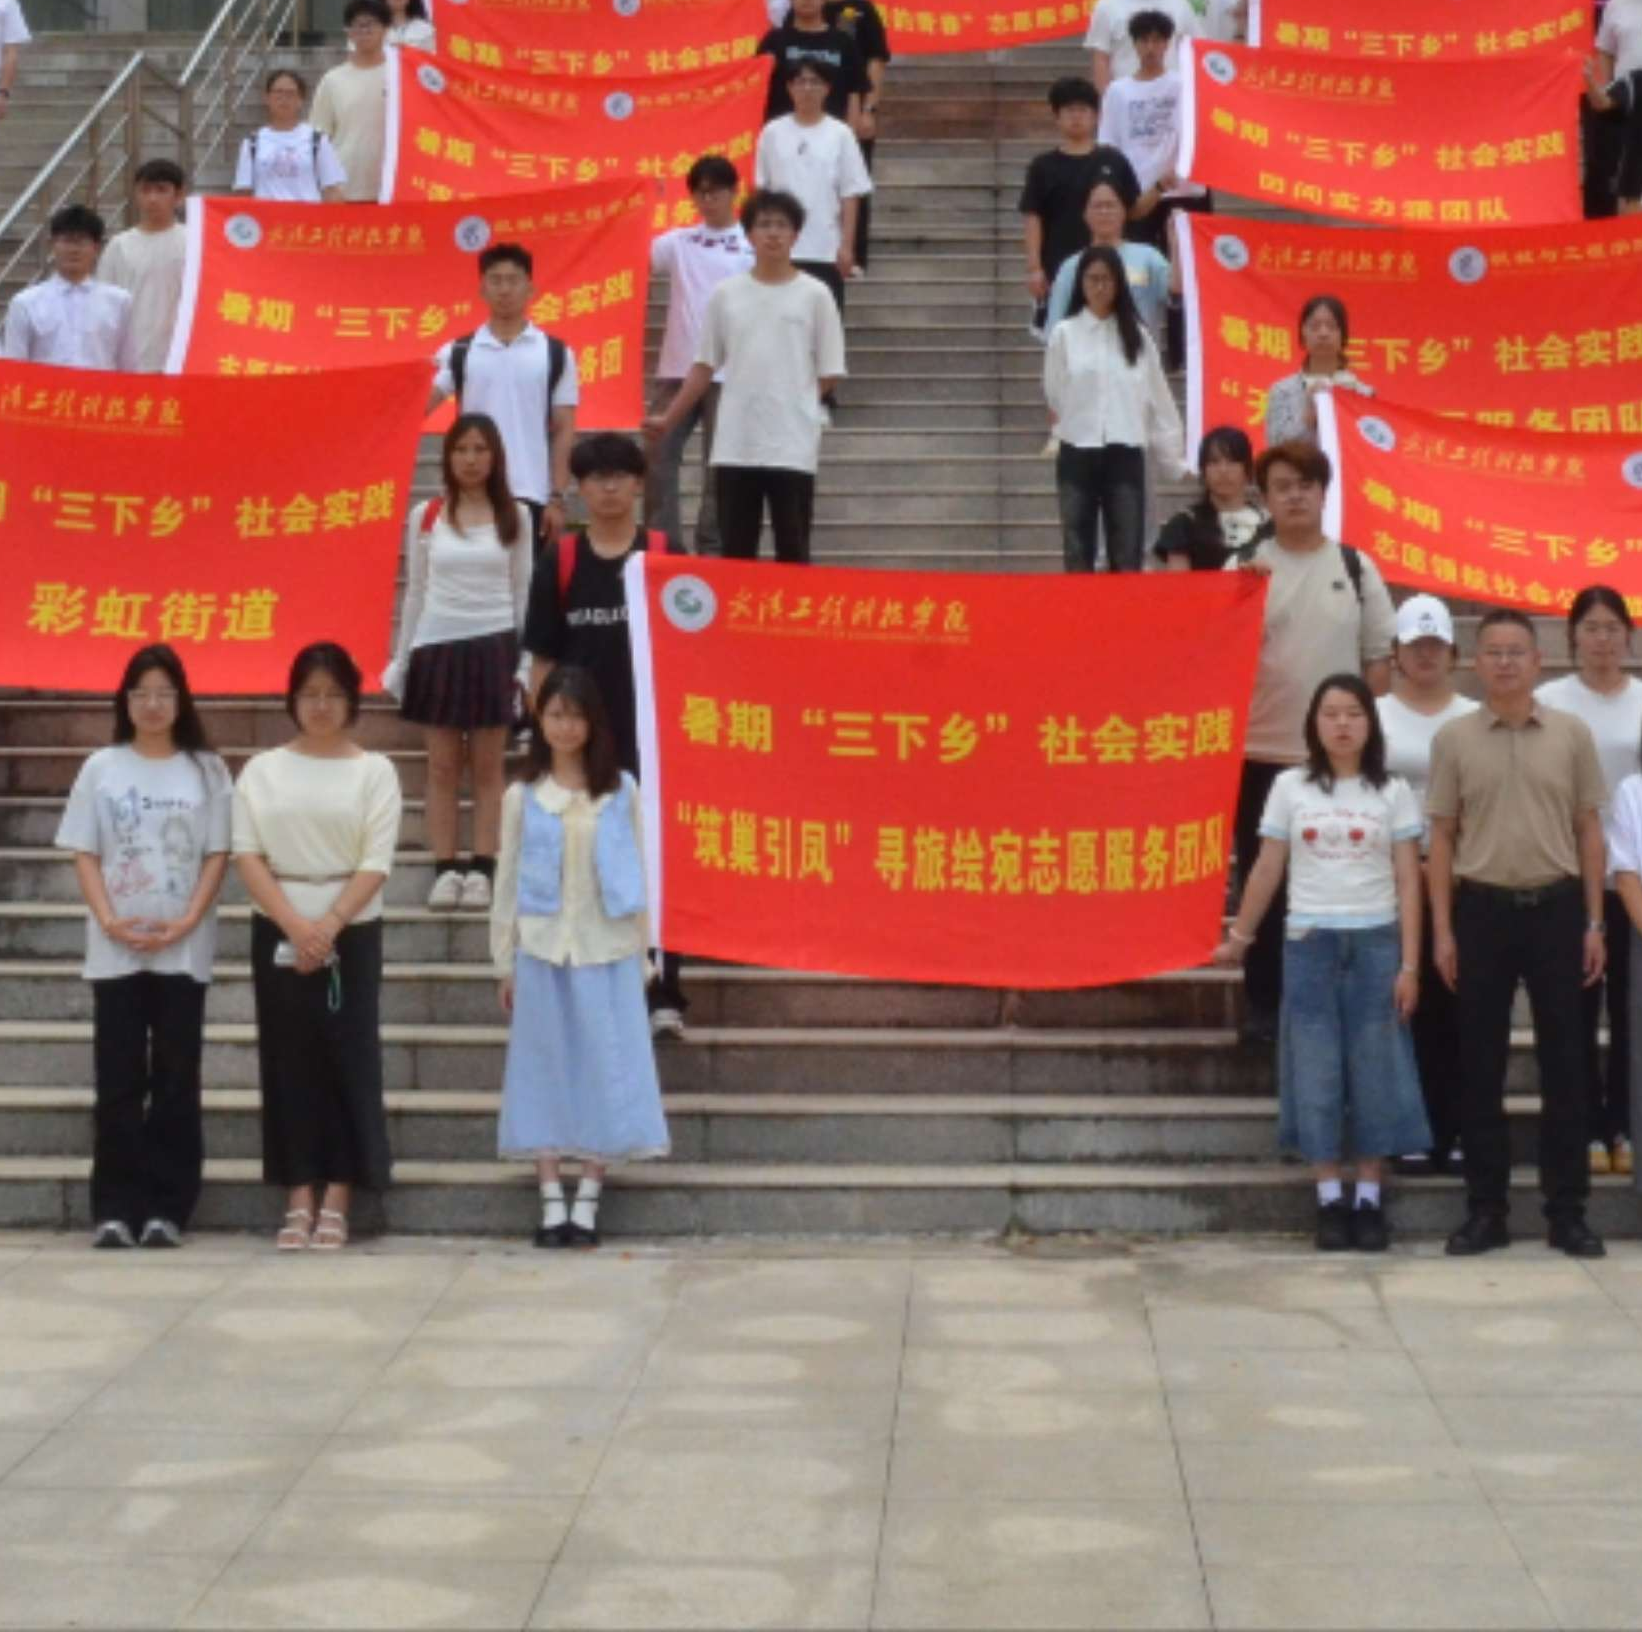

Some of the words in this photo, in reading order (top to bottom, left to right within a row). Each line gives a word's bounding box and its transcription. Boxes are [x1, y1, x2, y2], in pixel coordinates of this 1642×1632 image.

[1436, 130, 1566, 172] 社会实践
[216, 289, 294, 333] 暑期
[315, 303, 473, 340] “三下乡”
[32, 488, 212, 538] “三下乡”
[236, 480, 396, 540] 社会实践
[27, 581, 280, 643] 彩虹街道
[678, 694, 774, 754] 暑期
[801, 710, 1009, 764] “三下乡”
[1037, 707, 1234, 765] 社会实践
[676, 800, 852, 884] “筑巢引凤”
[873, 812, 1224, 896] 寻旅绘宛志愿服务团队
